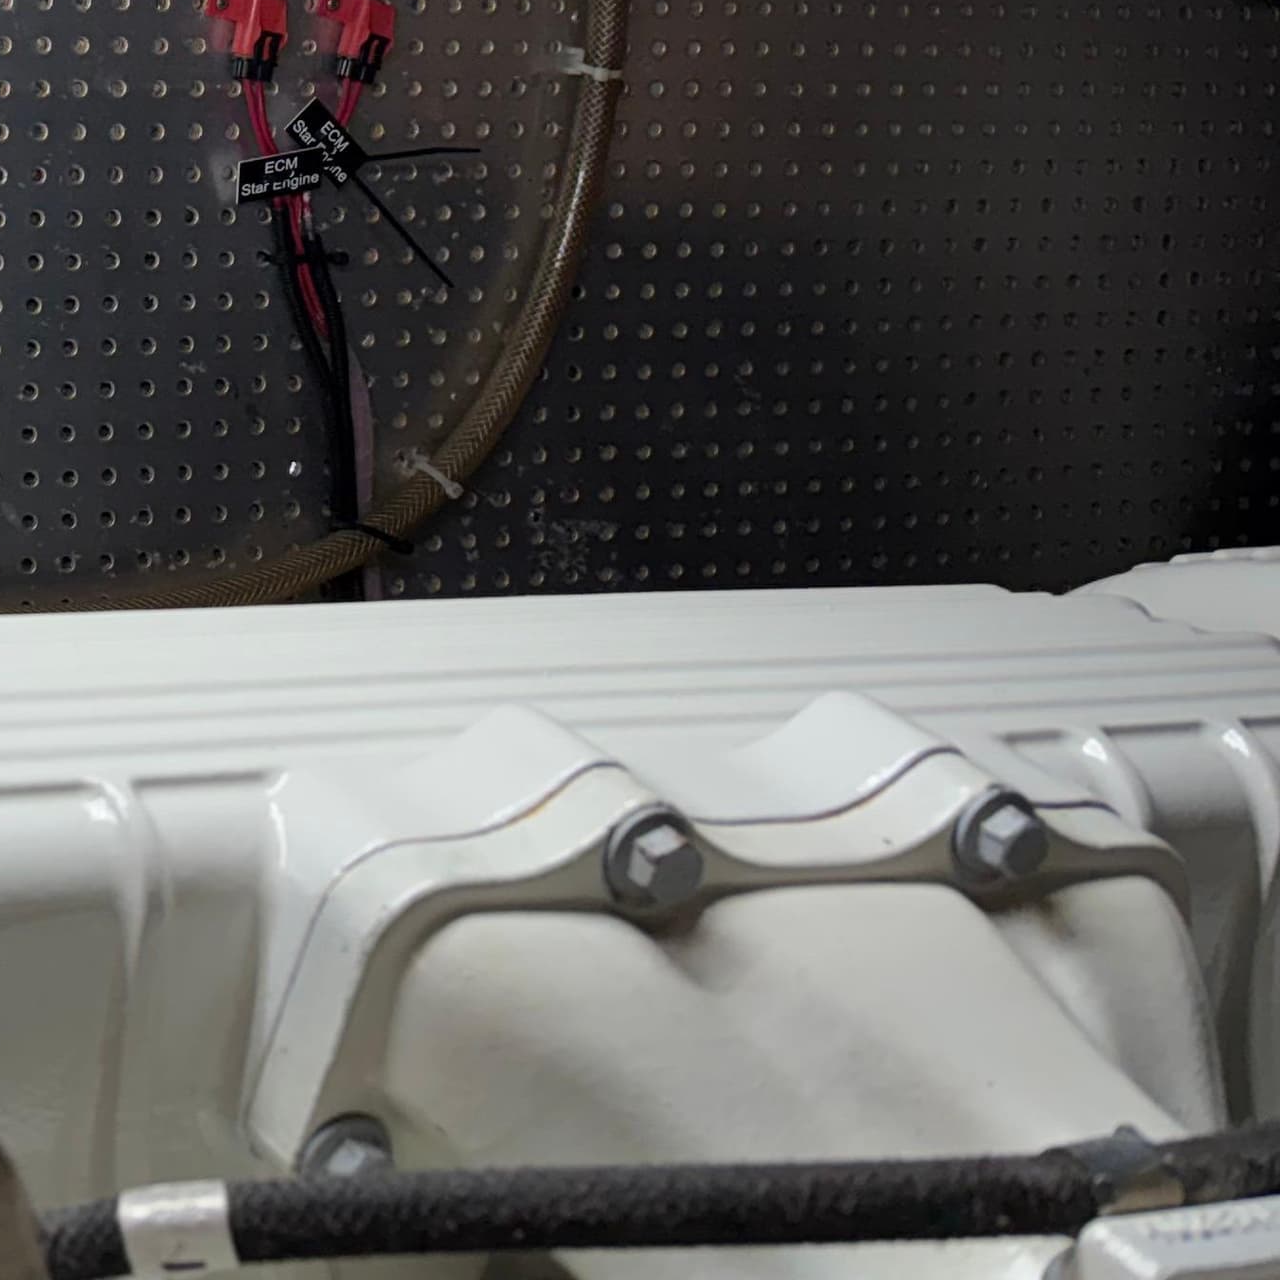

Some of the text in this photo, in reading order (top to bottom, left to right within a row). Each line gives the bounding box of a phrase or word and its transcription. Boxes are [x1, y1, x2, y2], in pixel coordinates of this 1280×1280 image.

[292, 119, 317, 146] Star
[320, 120, 350, 153] ECM
[264, 156, 298, 175] ECM
[241, 182, 270, 197] Star
